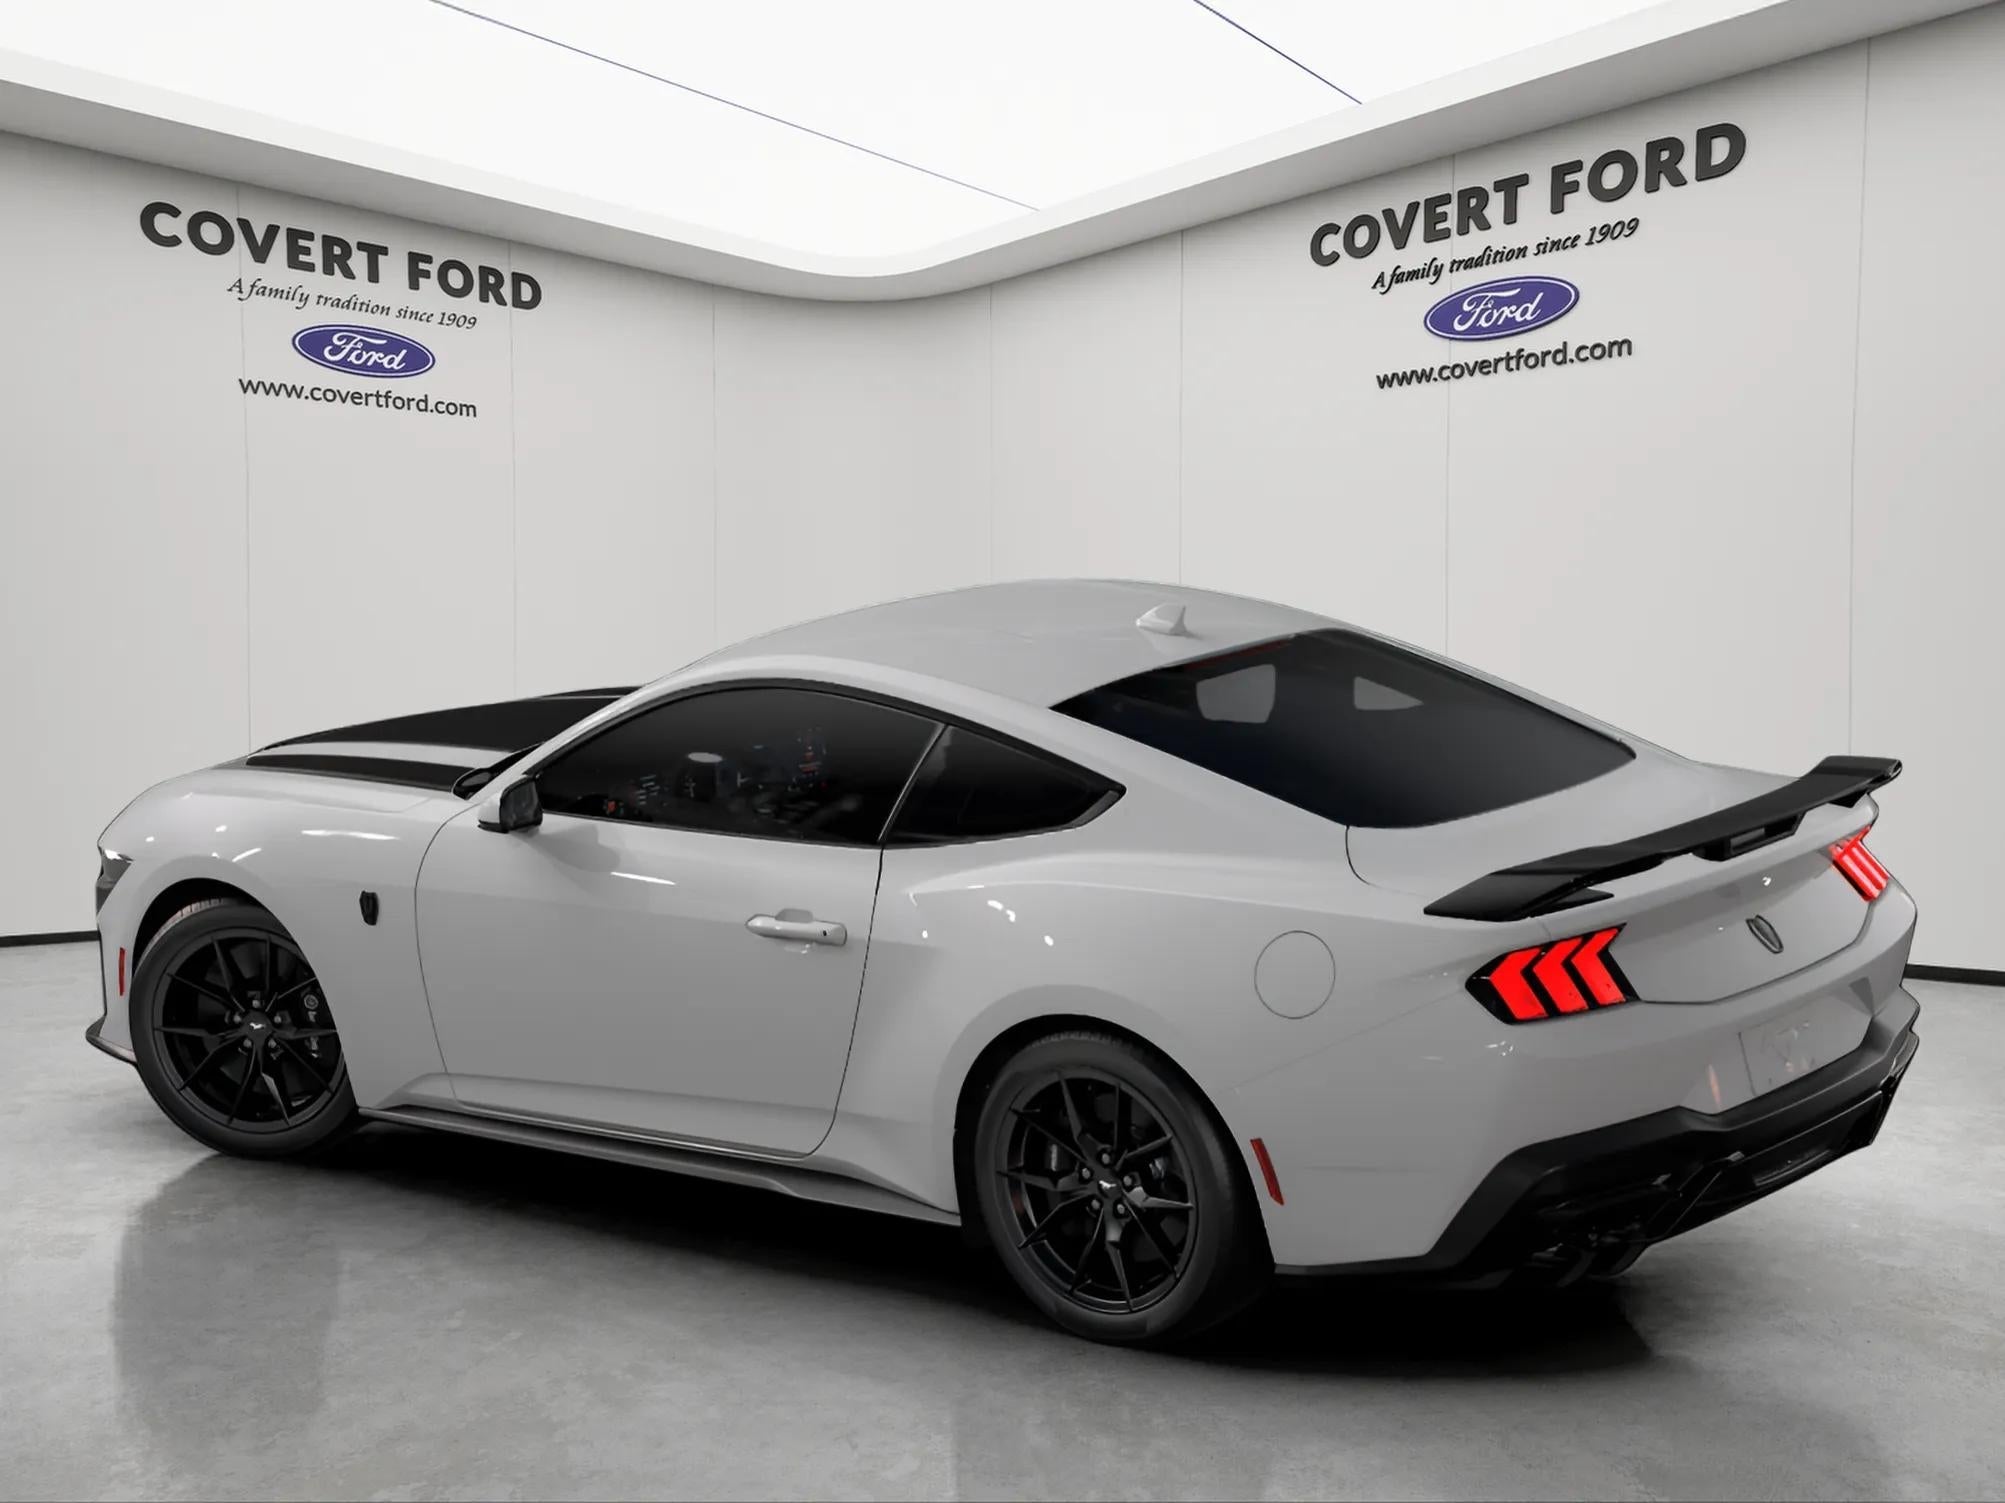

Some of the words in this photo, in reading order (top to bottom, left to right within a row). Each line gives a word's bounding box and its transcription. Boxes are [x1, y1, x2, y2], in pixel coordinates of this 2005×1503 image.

[1310, 173, 1529, 267] COVERT
[1550, 122, 1747, 215] FORD
[140, 201, 388, 284] COVERT
[407, 251, 542, 310] FORD
[1371, 270, 1387, 290] A
[1379, 257, 1444, 295] family
[1449, 245, 1528, 274] tradition
[1533, 234, 1581, 257] since
[1584, 218, 1640, 246] 1909
[227, 278, 245, 294] A
[237, 280, 310, 310] family
[316, 294, 391, 317] tradition
[396, 305, 433, 323] since
[438, 311, 477, 329] 1909
[1453, 288, 1541, 332] Ford
[323, 331, 406, 371] Ford
[1376, 338, 1633, 389] www.covertford.com
[238, 378, 477, 418] www.covertford.com
